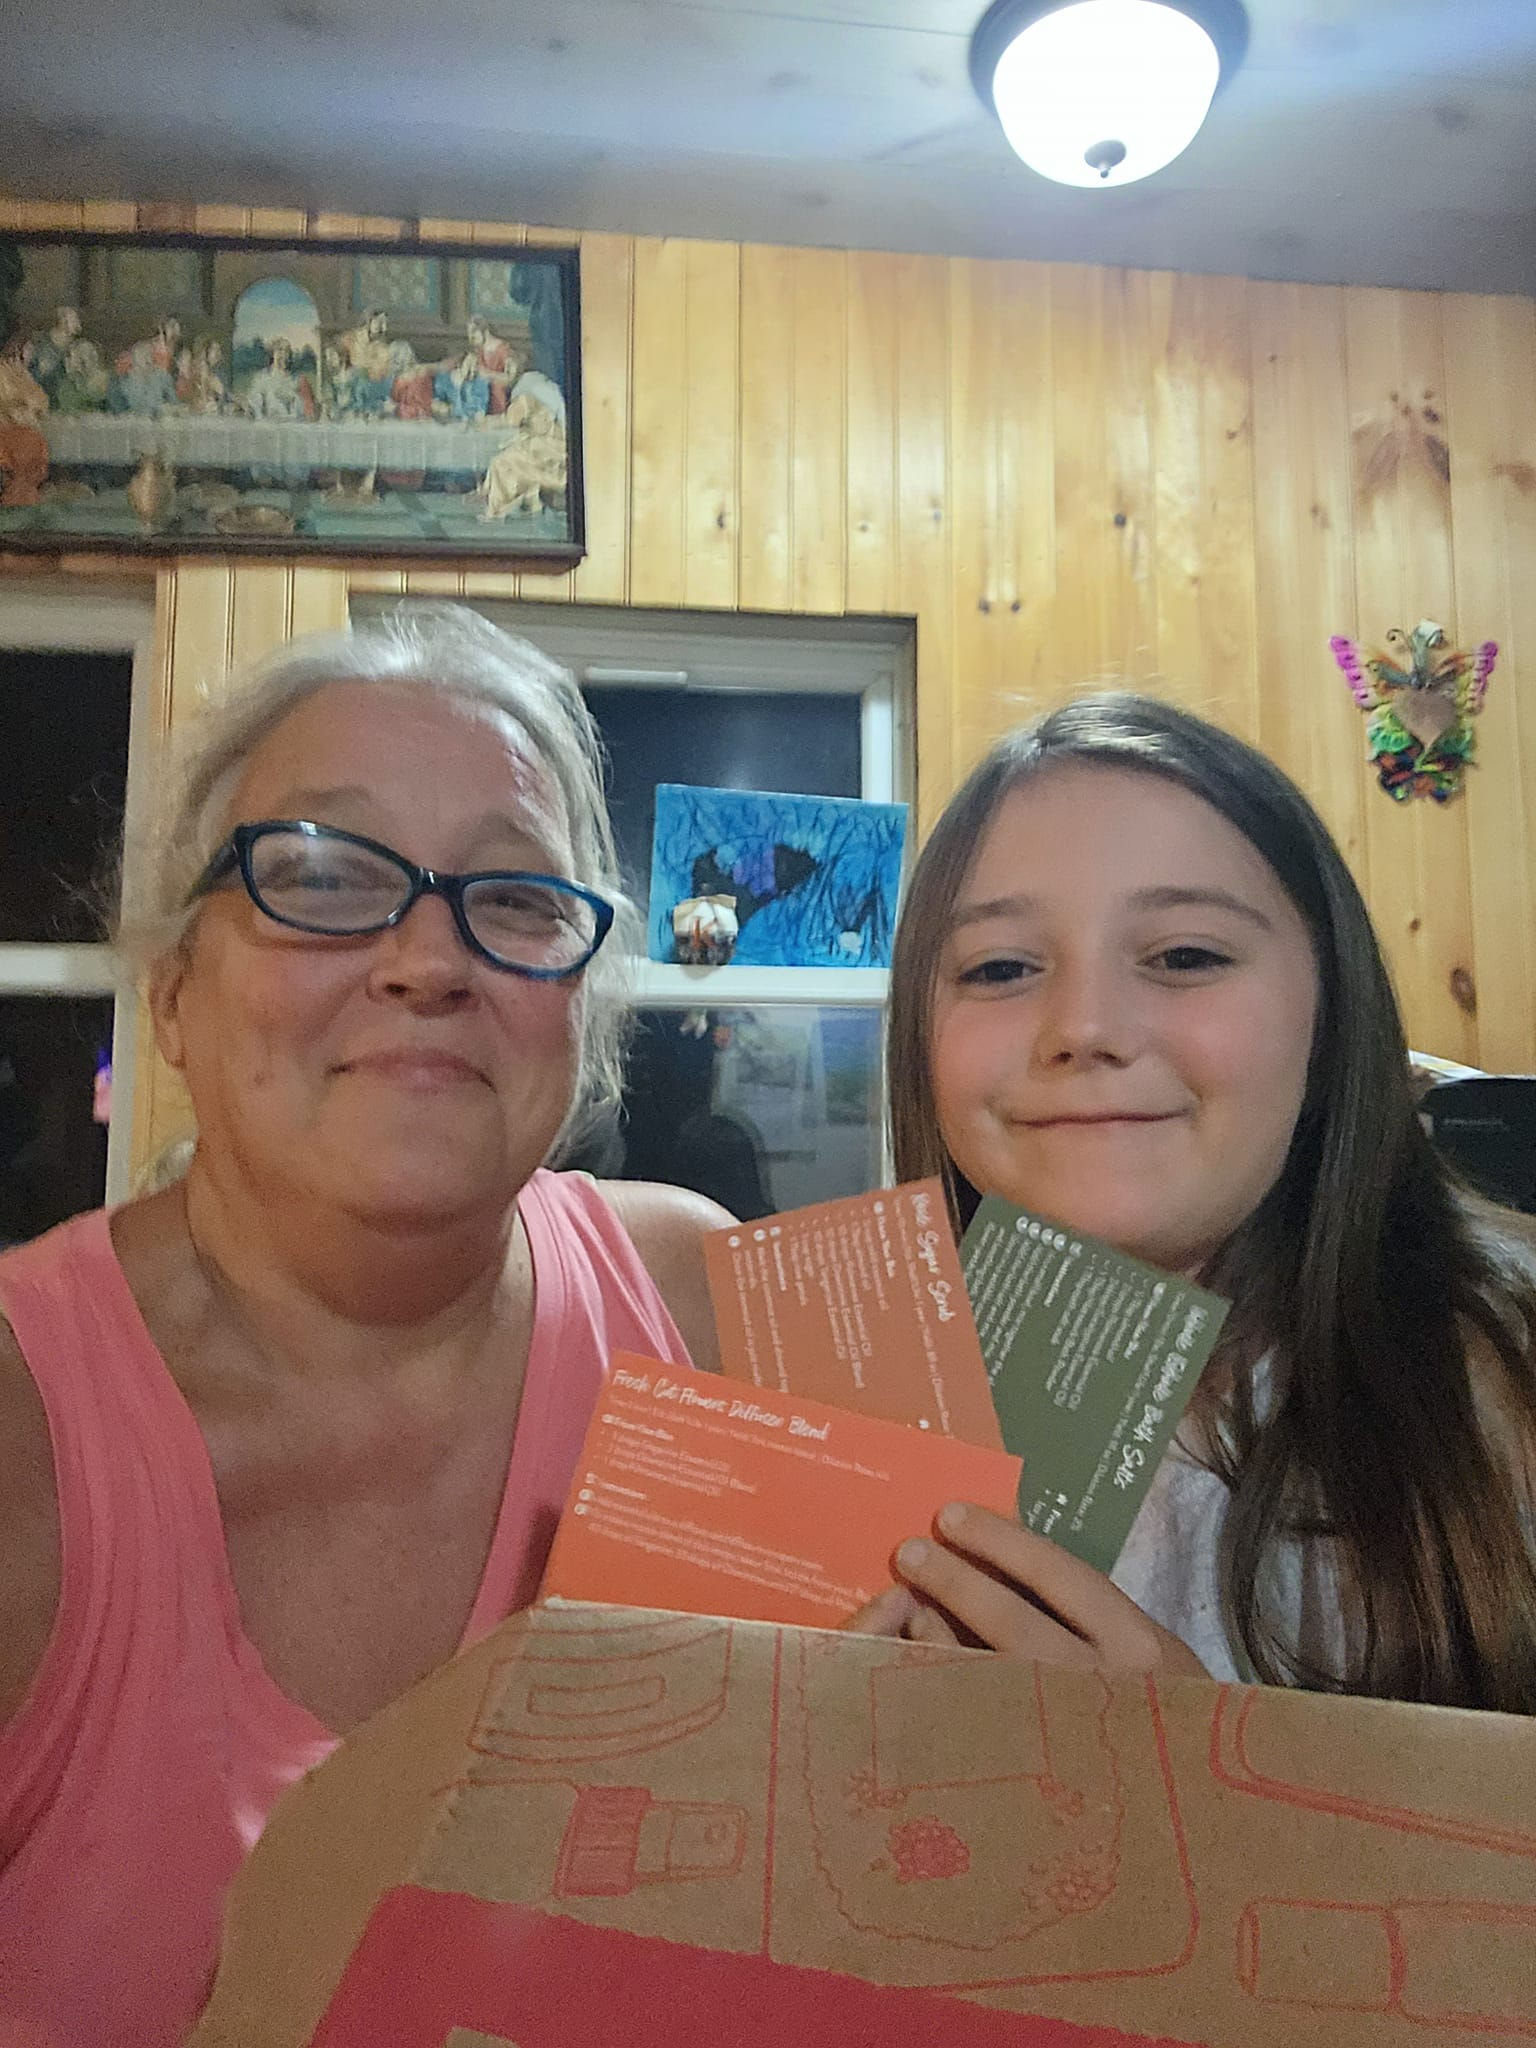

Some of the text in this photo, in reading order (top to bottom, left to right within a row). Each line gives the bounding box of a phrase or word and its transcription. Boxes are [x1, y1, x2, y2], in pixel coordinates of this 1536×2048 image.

[916, 1231, 941, 1274] Sugar
[927, 1280, 956, 1322] Scrub
[612, 1369, 650, 1393] Fresh
[788, 1416, 831, 1441] Blend
[1133, 1404, 1163, 1443] Bath
[1114, 1444, 1144, 1490] Salts
